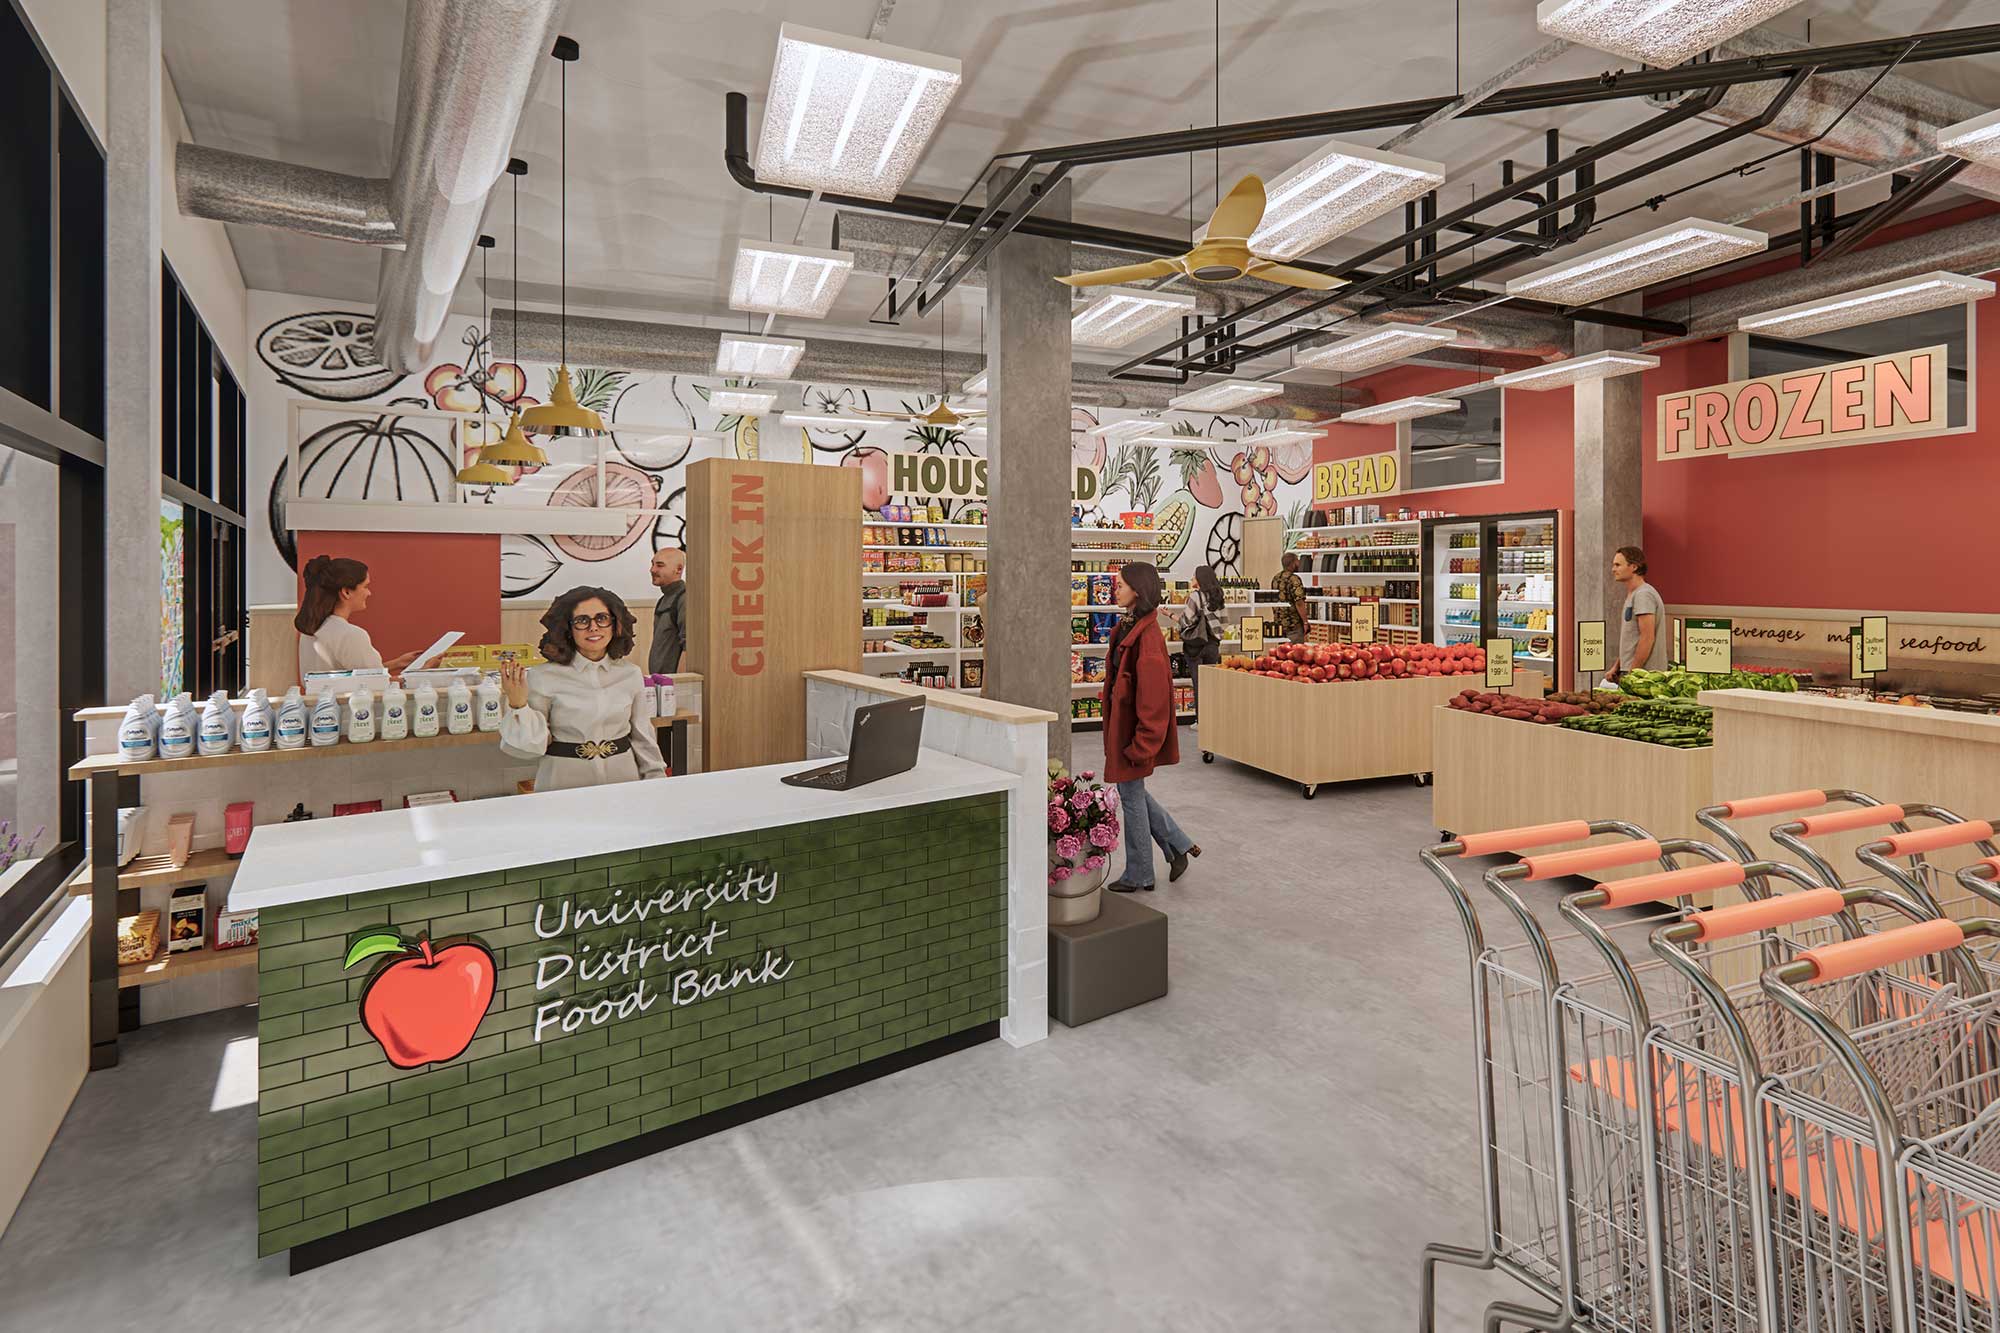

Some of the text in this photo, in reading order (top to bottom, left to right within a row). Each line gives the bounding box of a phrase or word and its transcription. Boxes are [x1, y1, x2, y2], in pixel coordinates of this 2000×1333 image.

[1664, 354, 1931, 453] FROZEN
[894, 454, 1096, 500] HOUSD
[1316, 455, 1396, 499] BREAD
[731, 475, 765, 676] CHECK IN
[1688, 637, 1729, 645] Cucumbers
[1731, 627, 1805, 643] everages
[1899, 636, 1987, 655] seafood
[534, 868, 778, 938] University
[535, 921, 728, 991] District
[534, 951, 795, 1041] Food Bank
